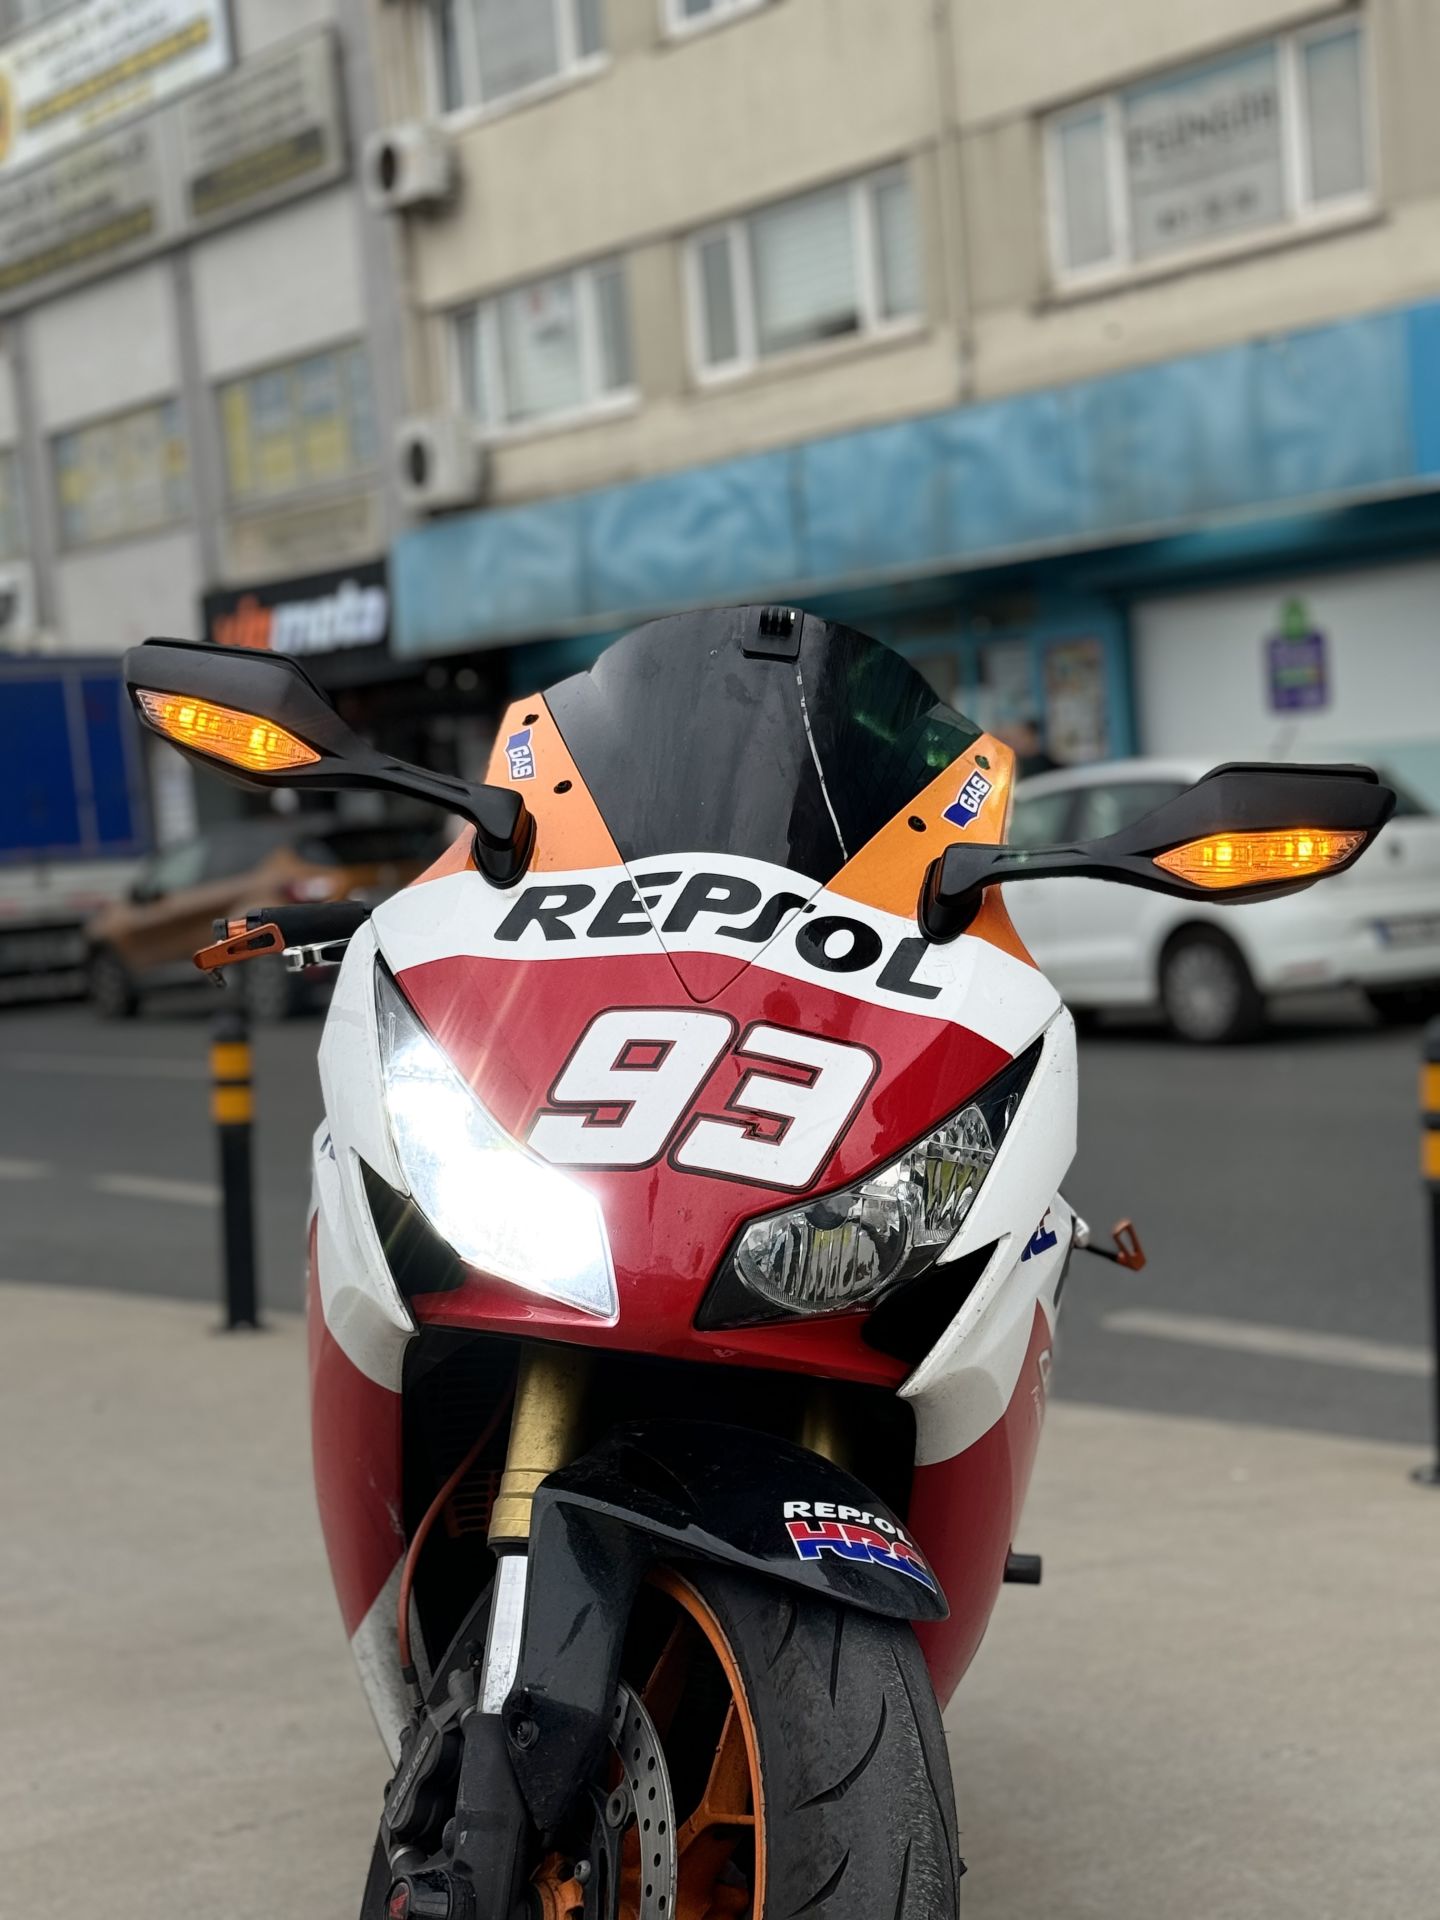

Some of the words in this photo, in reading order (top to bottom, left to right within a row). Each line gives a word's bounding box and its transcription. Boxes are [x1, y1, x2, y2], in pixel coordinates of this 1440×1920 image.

[508, 745, 533, 778] GAS
[959, 775, 990, 813] GAS
[494, 871, 943, 1000] REPSOL
[526, 1006, 882, 1194] 93
[783, 1501, 913, 1548] REPSOL
[391, 1736, 429, 1808] TOKICO
